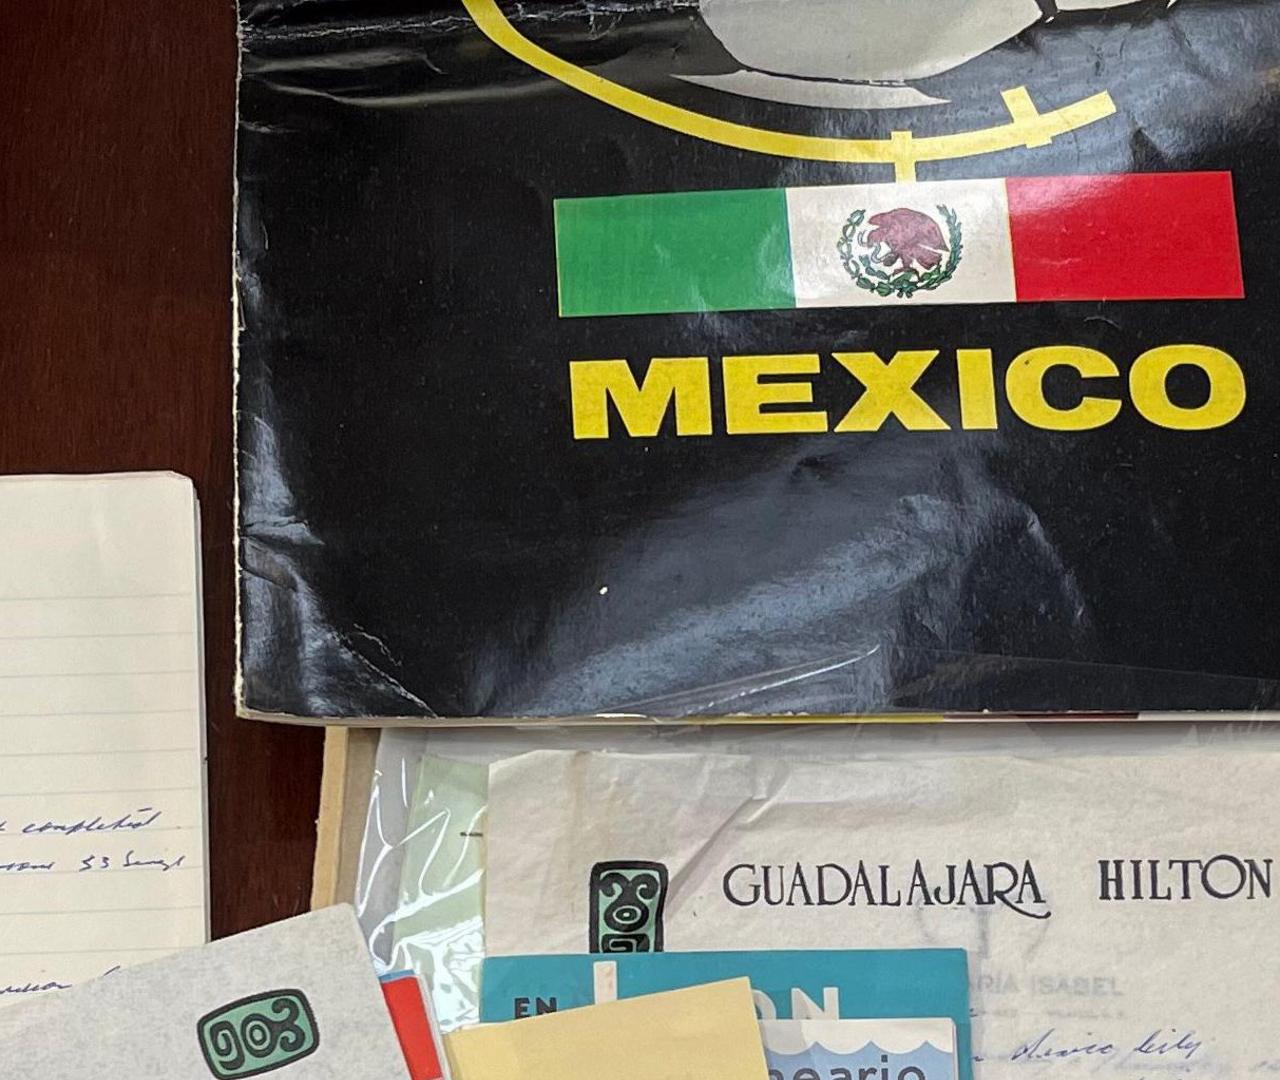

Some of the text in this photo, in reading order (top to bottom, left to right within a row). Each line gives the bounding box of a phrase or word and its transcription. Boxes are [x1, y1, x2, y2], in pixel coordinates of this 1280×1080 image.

[568, 343, 1247, 440] MEXICO
[721, 854, 1275, 919] GUADALAJARA HILTON
[514, 997, 558, 1020] EN
